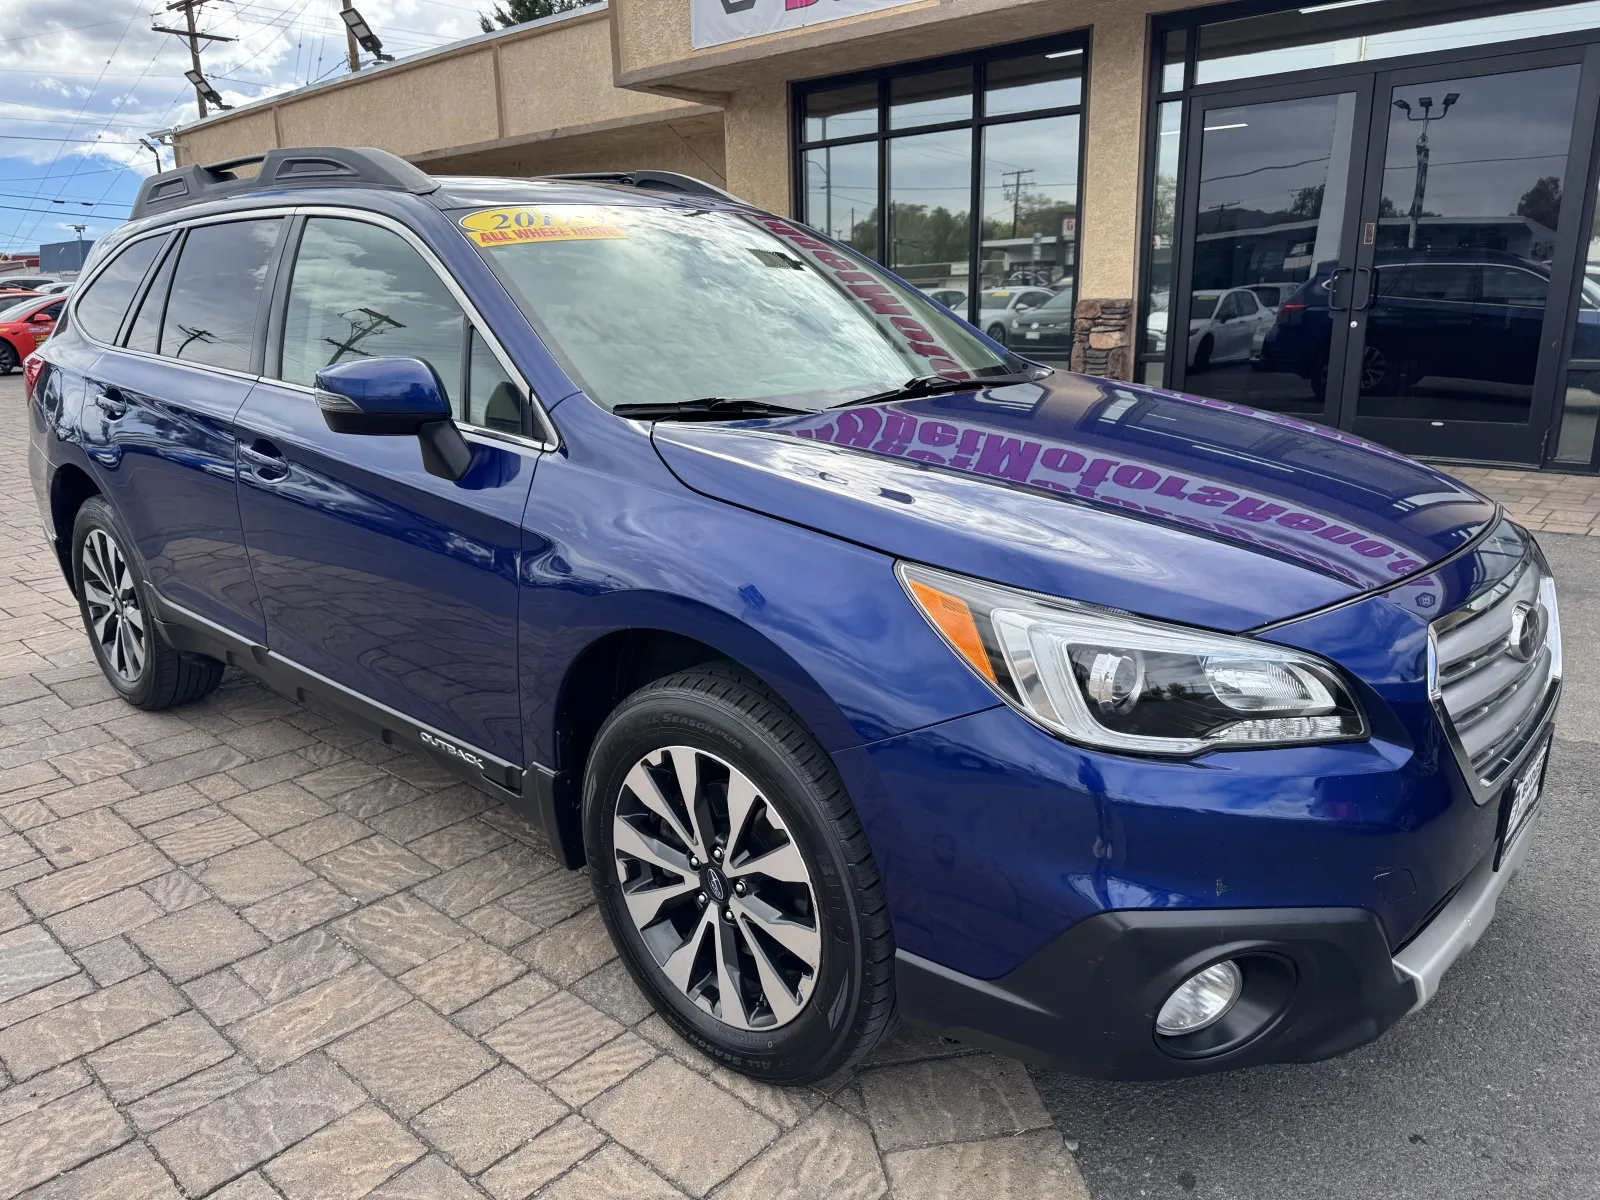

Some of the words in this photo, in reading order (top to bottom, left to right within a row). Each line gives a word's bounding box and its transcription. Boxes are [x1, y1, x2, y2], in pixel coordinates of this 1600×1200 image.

[491, 212, 576, 230] 201
[479, 230, 513, 244] ALL
[512, 227, 570, 240] WHEEL
[662, 712, 716, 734] SEASON
[420, 731, 484, 770] OUTBACK
